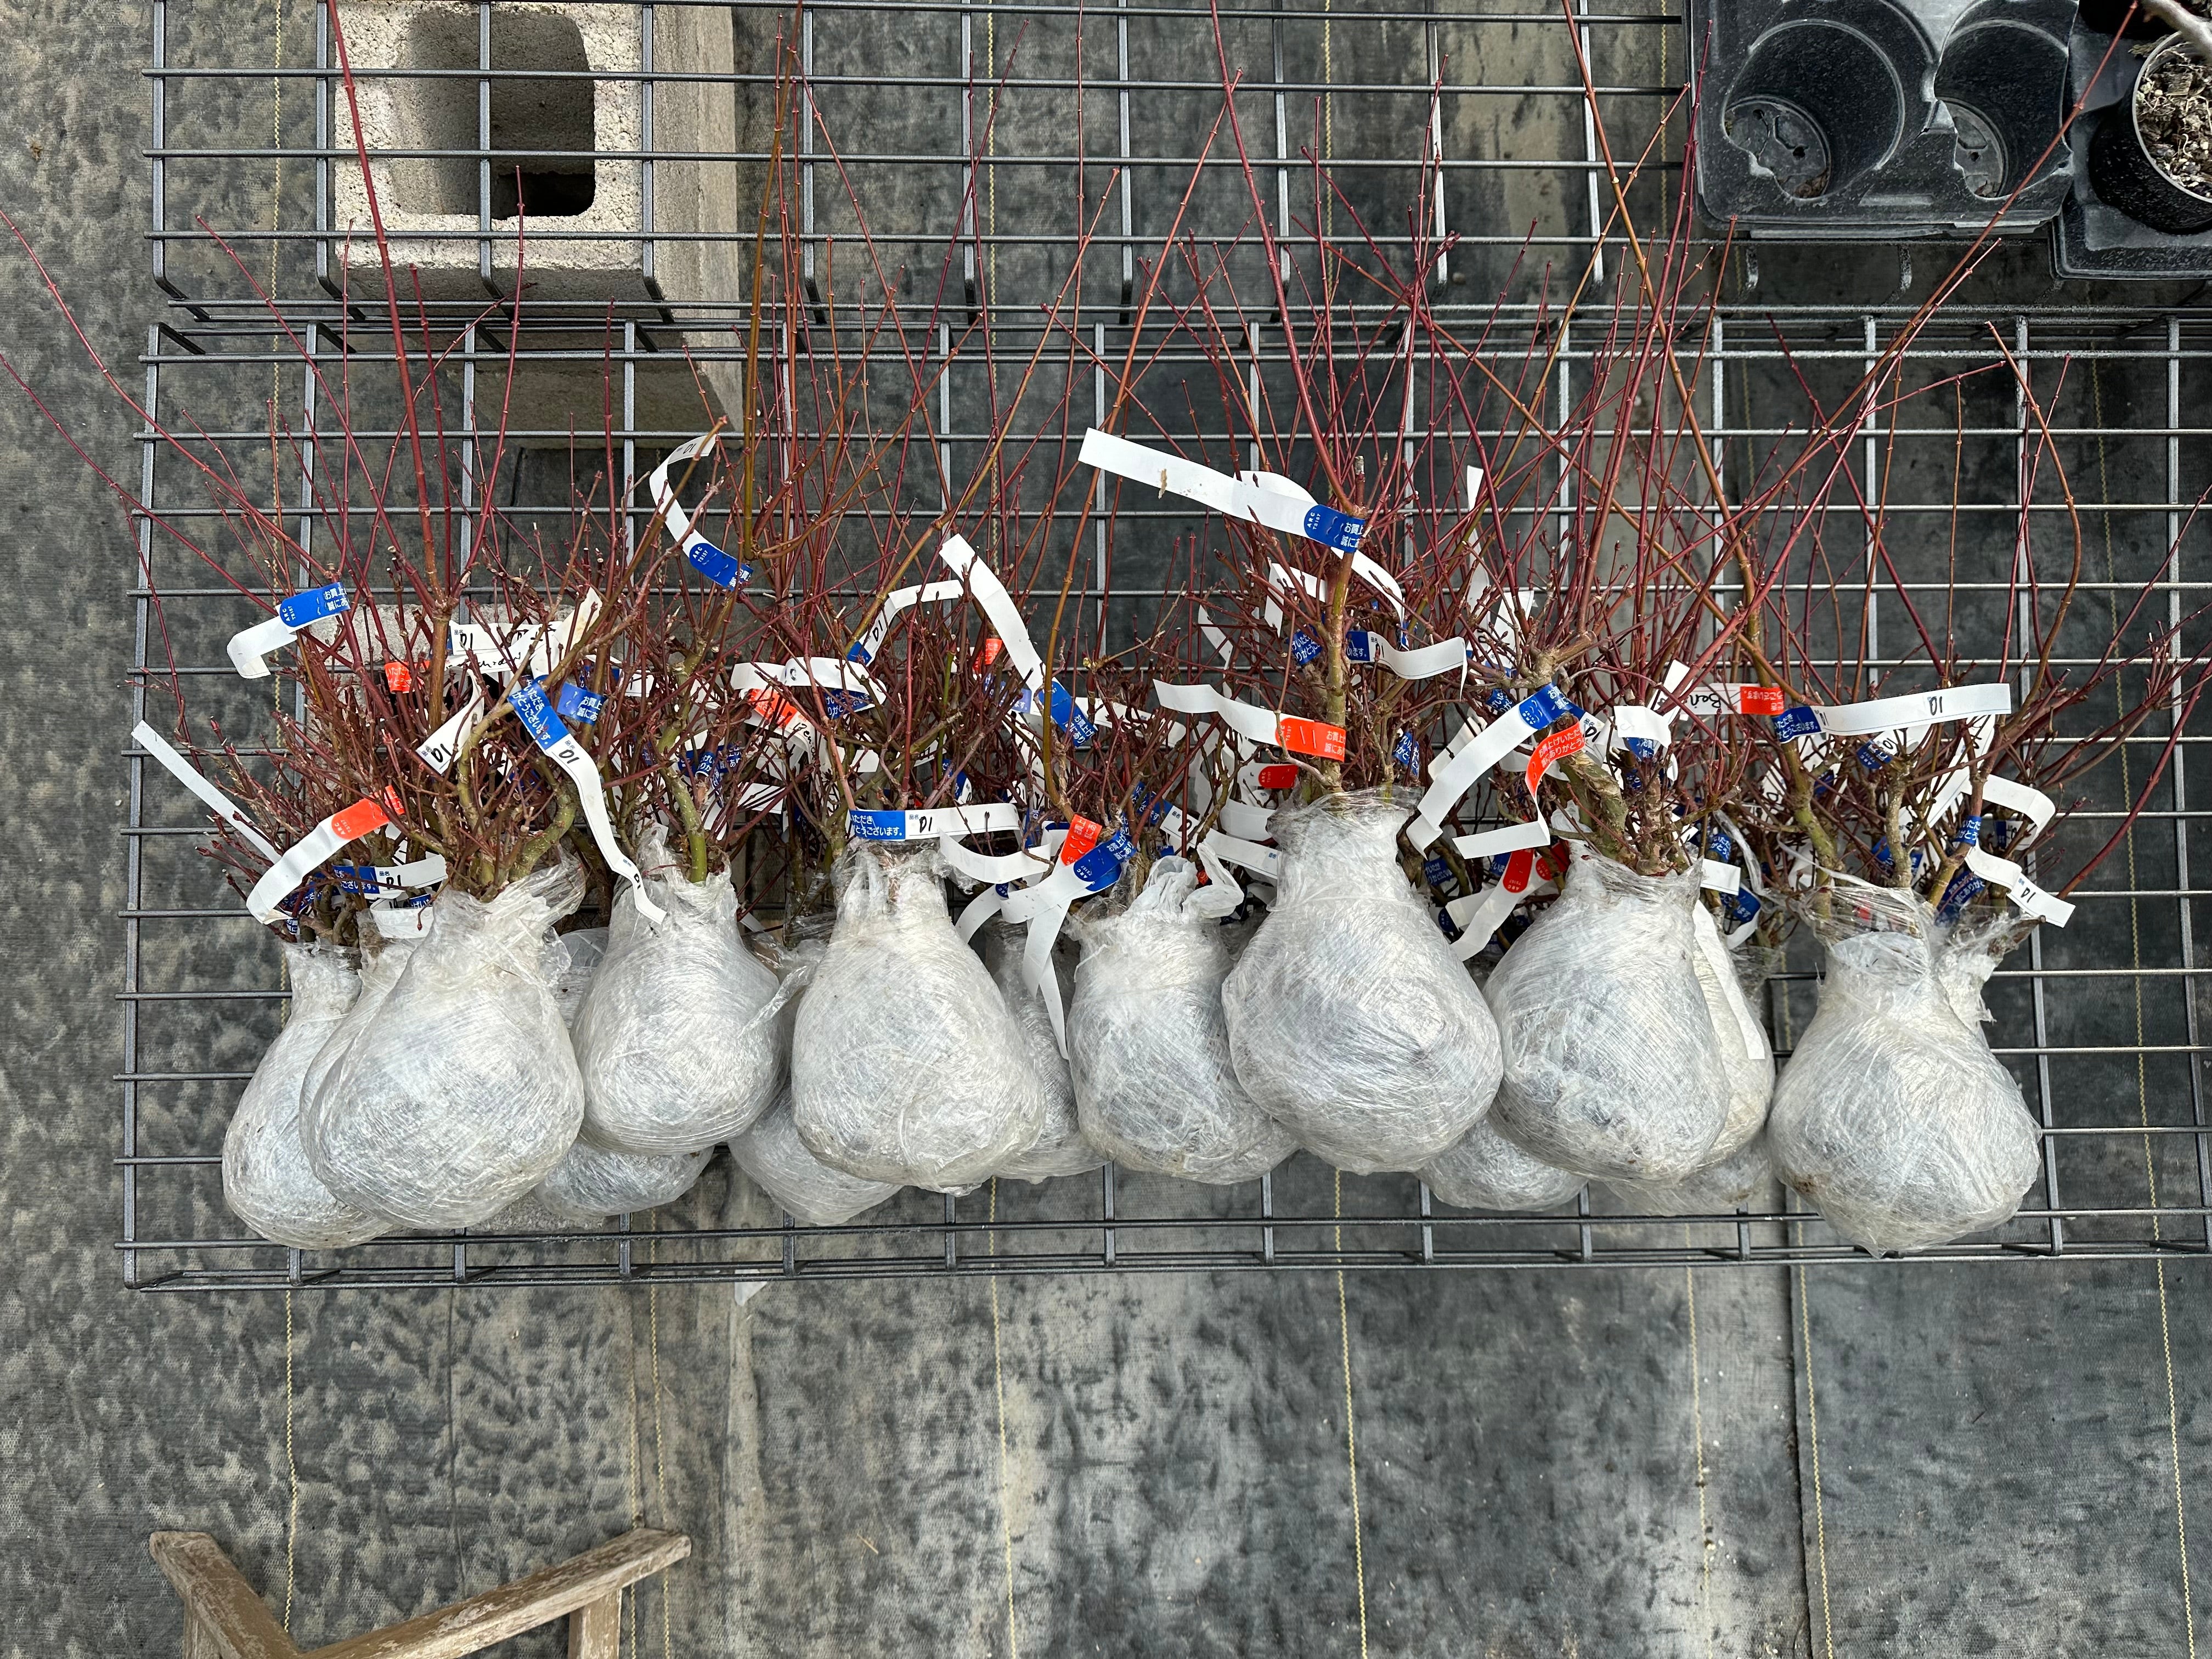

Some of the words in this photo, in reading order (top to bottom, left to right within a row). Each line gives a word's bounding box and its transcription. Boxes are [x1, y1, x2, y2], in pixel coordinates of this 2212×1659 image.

[1307, 512, 1316, 528] ARC
[693, 546, 702, 559] ARC
[282, 608, 291, 622] ARC
[334, 822, 346, 835] ARC
[1076, 868, 1088, 879] ARC
